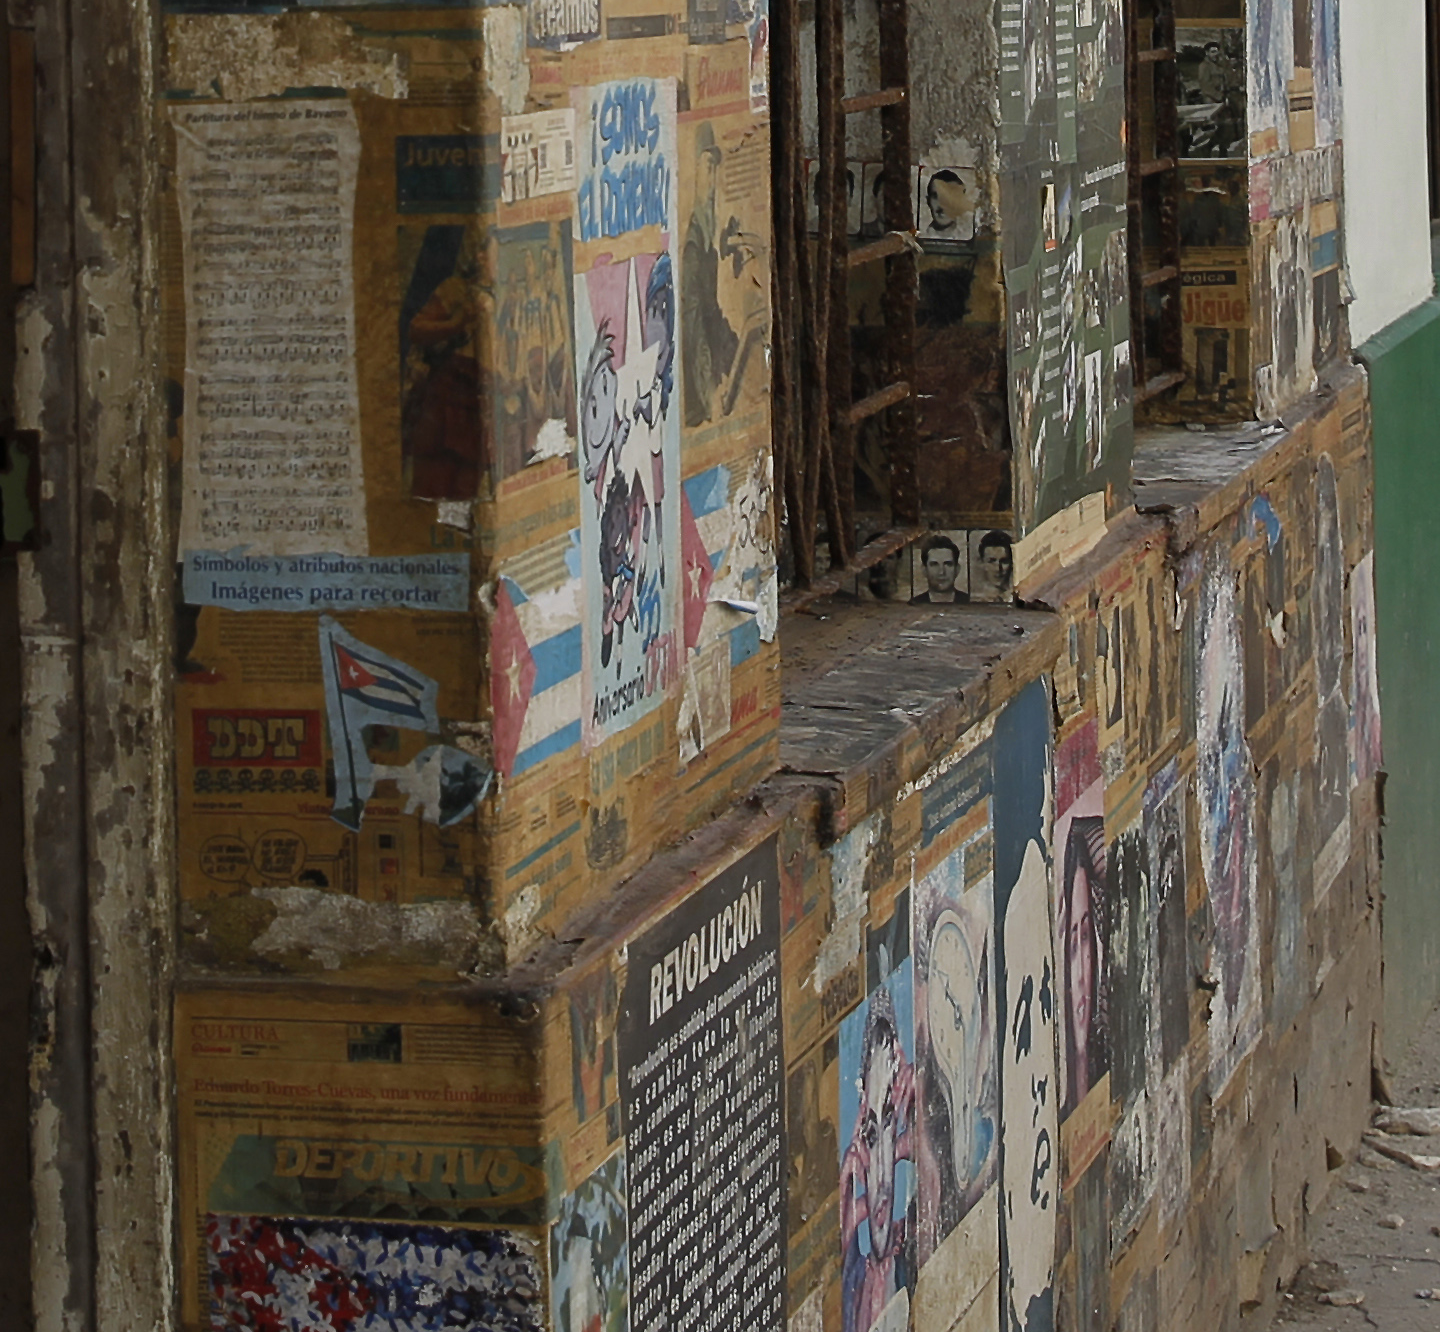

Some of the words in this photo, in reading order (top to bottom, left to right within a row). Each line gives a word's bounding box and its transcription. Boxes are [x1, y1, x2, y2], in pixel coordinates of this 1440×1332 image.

[185, 109, 231, 125] Partitura
[233, 108, 252, 122] del
[288, 108, 303, 120] de
[193, 554, 270, 574] Símbolos
[273, 560, 283, 576] y
[288, 556, 364, 574] atributos
[369, 559, 460, 576] nacionales
[211, 581, 303, 604] Imágenes
[309, 586, 355, 605] para
[360, 587, 442, 603] recortar
[592, 665, 645, 729] Aniversario
[206, 715, 308, 761] DDT
[649, 875, 762, 1025] REVOLUCIÓN
[191, 1024, 279, 1041] CULTURA
[645, 1054, 686, 1103] cambiar
[692, 1030, 715, 1061] todo
[755, 976, 776, 1006] debe
[194, 1077, 259, 1095] Eduardo
[261, 1080, 375, 1102] Torres-Cuevas,
[380, 1088, 410, 1102] una
[413, 1089, 440, 1102] voz
[629, 1124, 642, 1150] ser
[677, 1109, 690, 1133] ser
[665, 1139, 689, 1173] como
[694, 1111, 720, 1146] seres
[632, 1239, 646, 1267] con
[651, 1198, 688, 1247] nuestros
[634, 1284, 661, 1326] dentro
[702, 1222, 716, 1252] del
